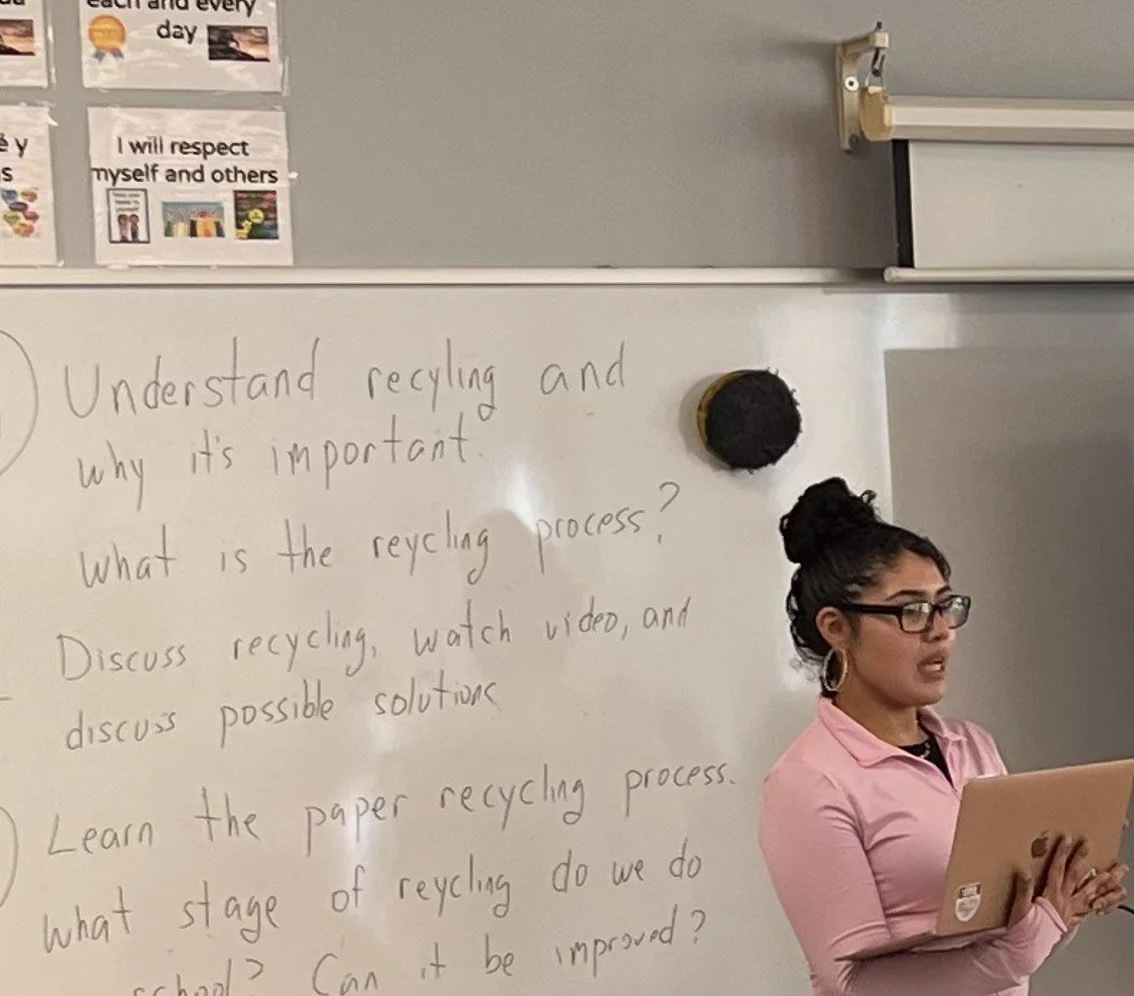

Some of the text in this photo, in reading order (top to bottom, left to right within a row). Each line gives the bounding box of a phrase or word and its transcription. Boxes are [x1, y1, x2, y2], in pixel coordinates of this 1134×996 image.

[157, 20, 198, 44] day
[91, 164, 280, 187] myself and others
[117, 136, 250, 160] I will respect
[65, 336, 320, 418] Understand
[540, 341, 626, 395] and
[78, 440, 143, 511] why
[191, 429, 234, 474] it's
[221, 548, 248, 574] is
[277, 518, 333, 573] the
[535, 481, 681, 575] process?
[57, 633, 187, 681] Discuss
[414, 599, 511, 656] watch
[546, 595, 629, 641] video,
[642, 596, 692, 630] and
[65, 710, 178, 751] discuss
[220, 678, 335, 748] possible
[47, 762, 736, 858] Learn the paper recycling process.
[179, 880, 281, 944] stage
[331, 865, 366, 912] of
[552, 849, 588, 893] do
[612, 859, 645, 886] we
[669, 837, 701, 879] do
[421, 942, 447, 979] it
[485, 933, 515, 978] be
